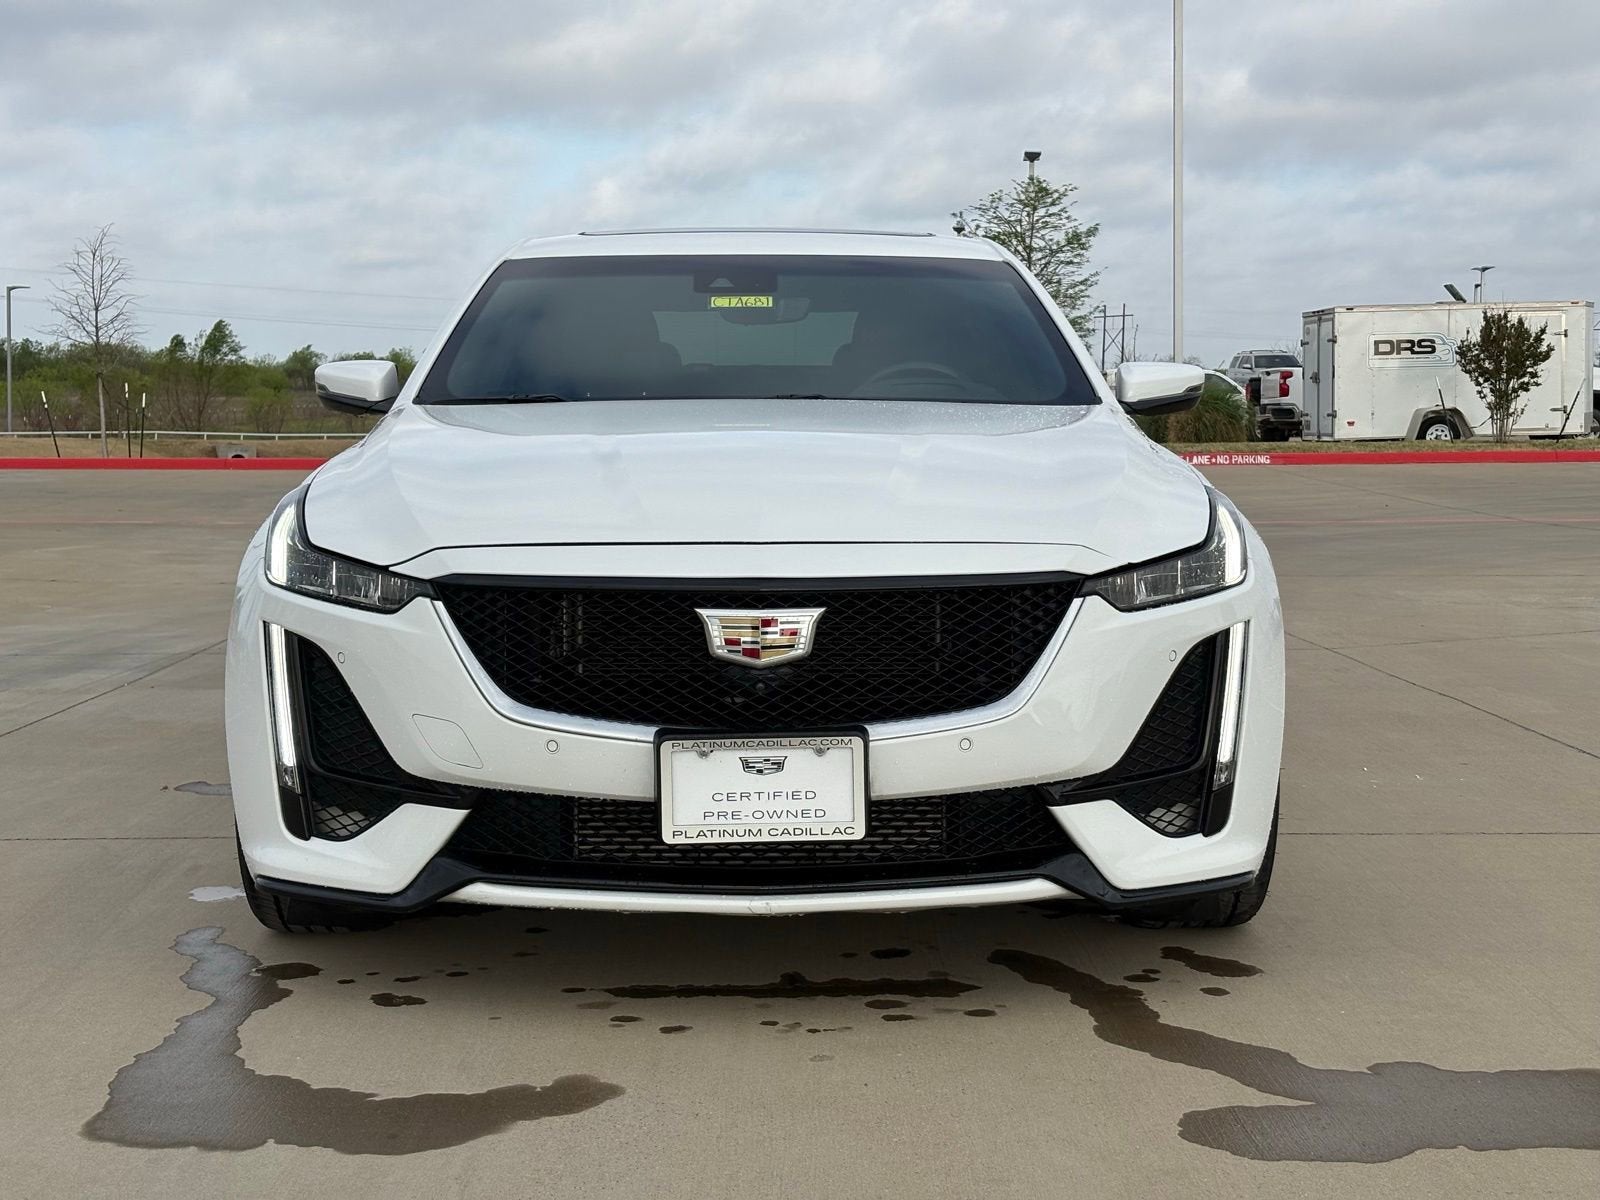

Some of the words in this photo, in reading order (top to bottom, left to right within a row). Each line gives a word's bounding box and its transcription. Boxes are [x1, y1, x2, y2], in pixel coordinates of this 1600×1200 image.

[1374, 338, 1437, 355] DRS
[1186, 455, 1211, 464] LANE
[1217, 455, 1230, 464] NO
[1232, 455, 1270, 464] PARKING
[711, 790, 817, 802] CERTIFIED
[703, 808, 827, 821] PRE-OWNED
[672, 828, 762, 839] PLATINUM
[767, 826, 855, 837] CADILLAC
